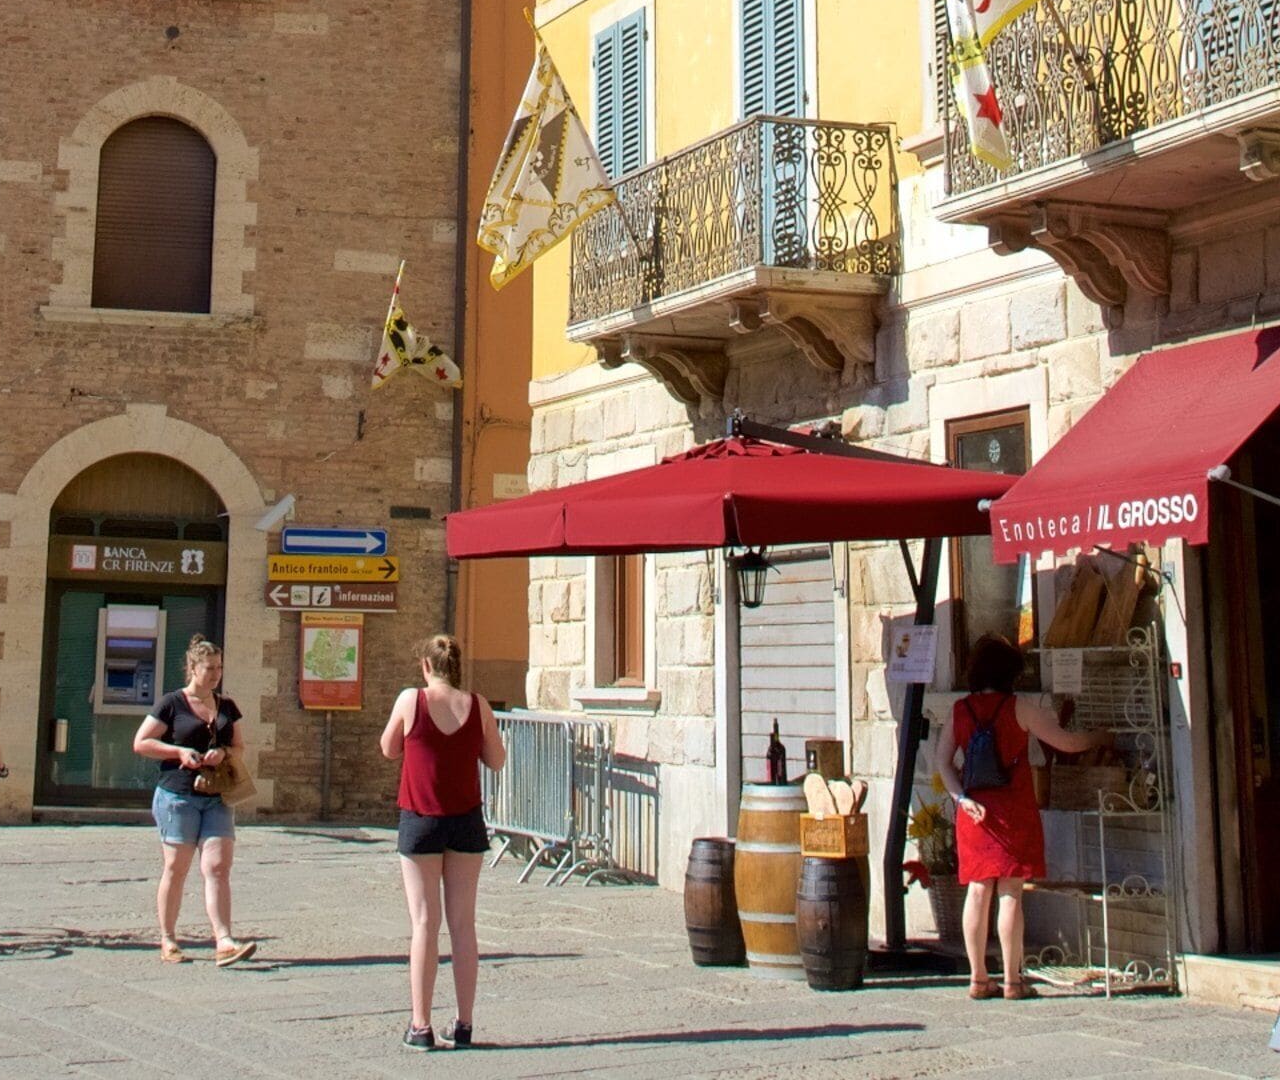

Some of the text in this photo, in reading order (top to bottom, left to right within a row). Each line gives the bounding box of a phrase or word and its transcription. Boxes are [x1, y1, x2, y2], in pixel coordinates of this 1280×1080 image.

[999, 514, 1081, 542] Enoteca
[1097, 504, 1114, 530] IL
[1118, 493, 1198, 529] GROSSO
[103, 546, 147, 559] BANCA
[102, 560, 175, 573] CR FIRENZE
[272, 562, 305, 574] Antico
[308, 563, 349, 575] frantoio
[339, 590, 394, 602] informazioni
